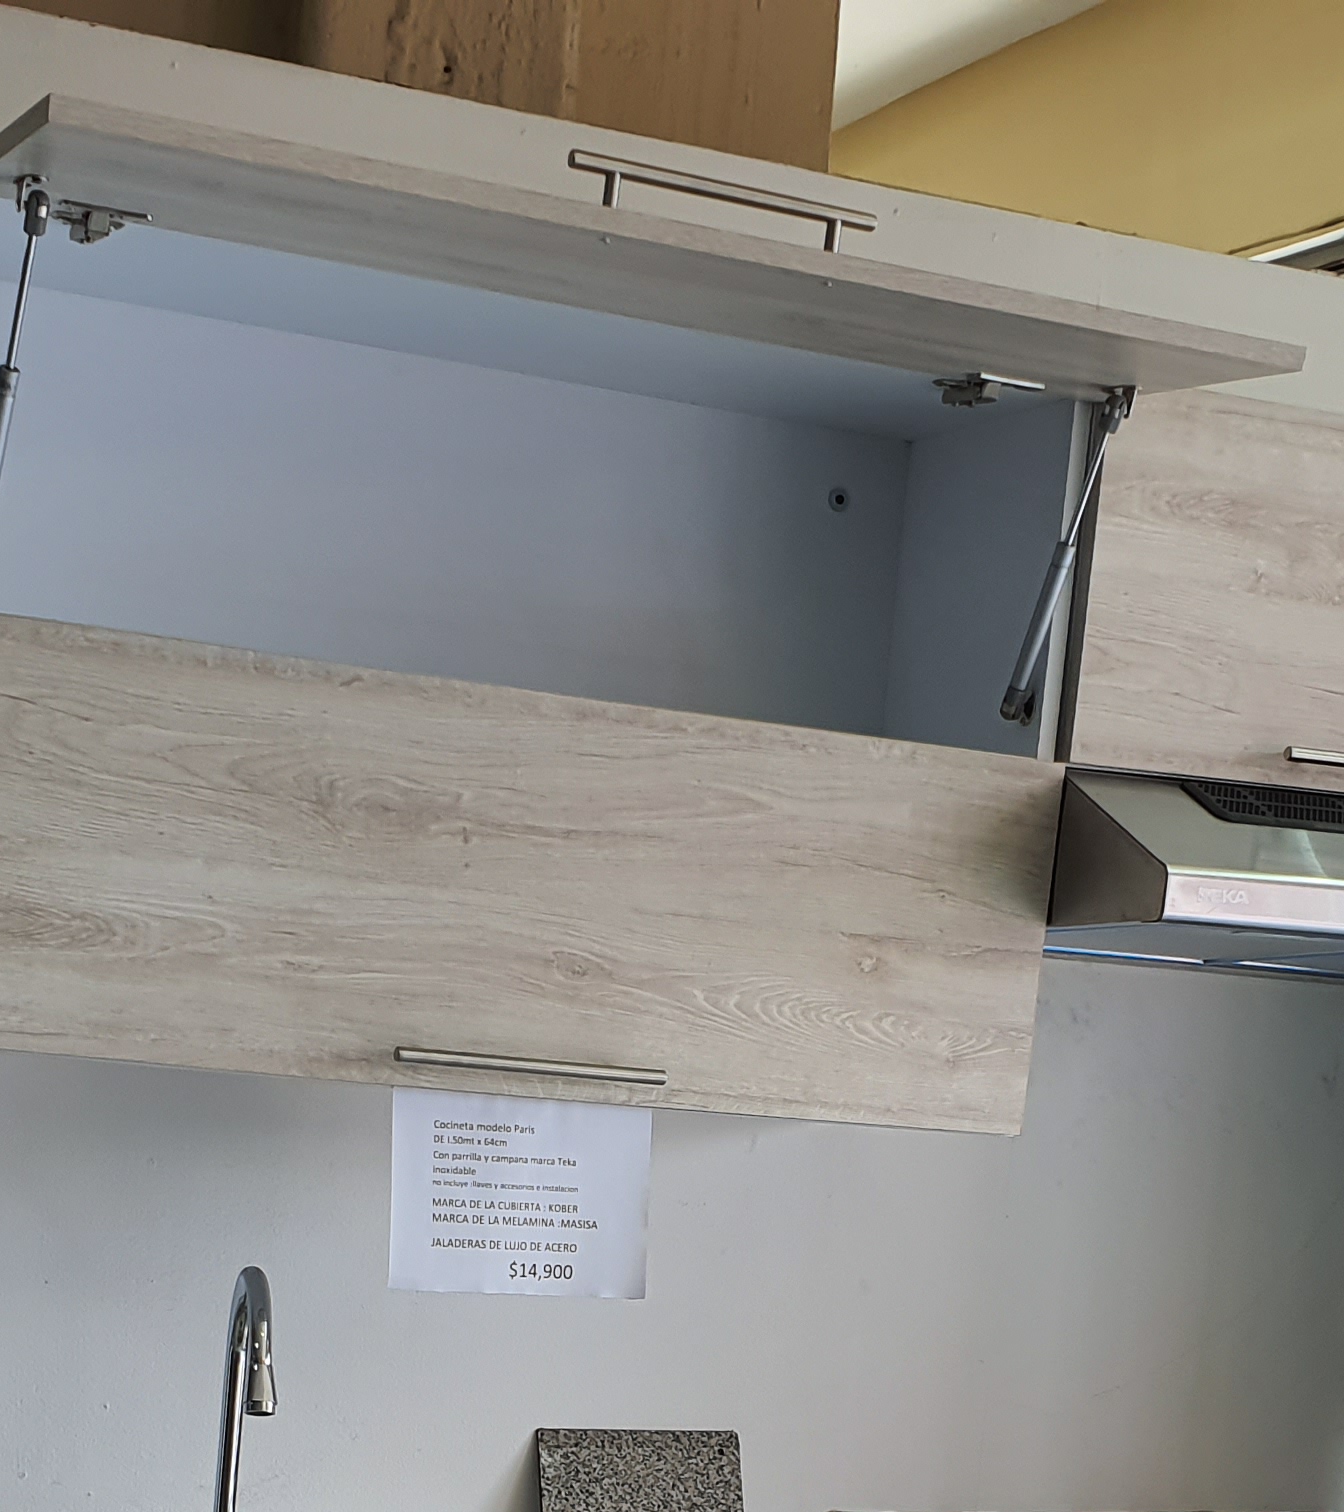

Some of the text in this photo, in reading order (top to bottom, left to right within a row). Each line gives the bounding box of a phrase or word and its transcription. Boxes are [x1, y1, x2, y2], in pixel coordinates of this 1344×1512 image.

[433, 1120, 474, 1131] Cocineta
[476, 1123, 512, 1133] modelo
[433, 1135, 445, 1144] DE
[433, 1151, 449, 1160] Con
[451, 1152, 482, 1162] parrilla
[491, 1155, 529, 1165] campana
[531, 1157, 556, 1166] marca
[557, 1157, 577, 1167] Teka
[500, 1183, 535, 1191] accesorios
[432, 1198, 467, 1208] MARCA
[469, 1200, 482, 1209] DE
[484, 1200, 496, 1210] LA
[498, 1201, 541, 1212] CUBIERTA
[548, 1203, 579, 1213] KOBER
[432, 1213, 470, 1224] MARCA
[472, 1215, 485, 1225] DE
[488, 1215, 500, 1226] LA
[502, 1216, 555, 1228] MELAMINA
[430, 1237, 578, 1253] JALADERAS DE LUJO DE ACERO
[508, 1260, 574, 1281] $14,900
